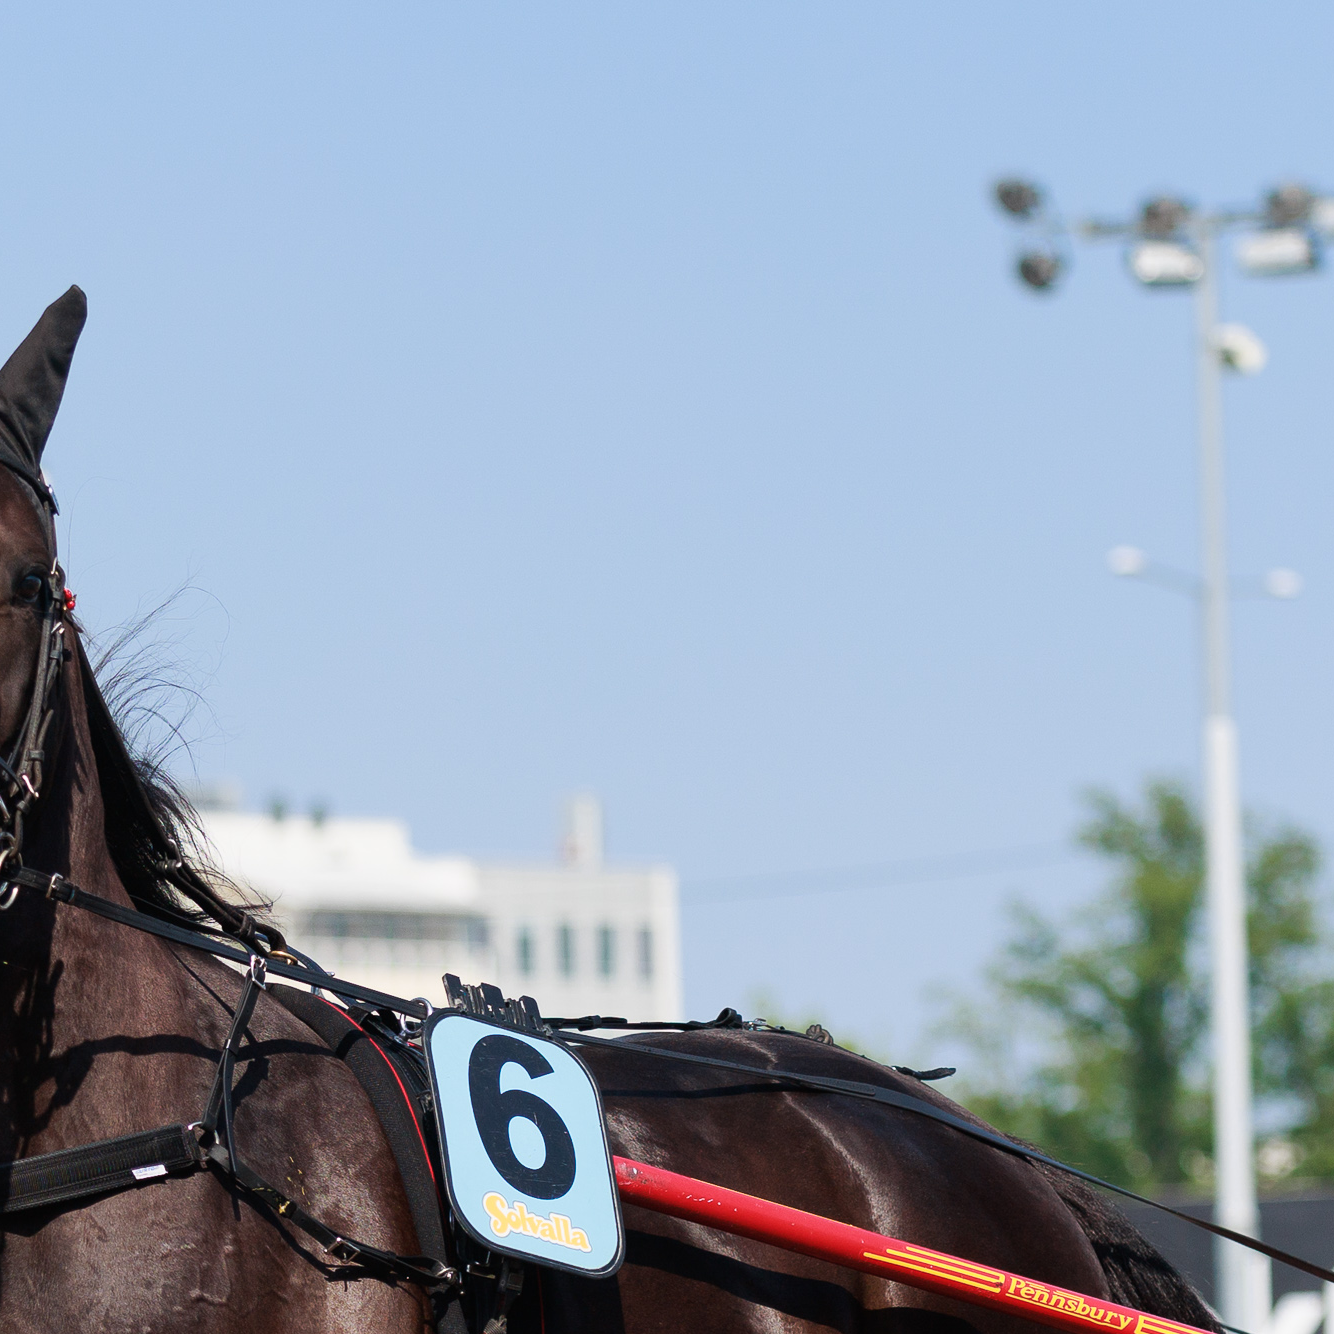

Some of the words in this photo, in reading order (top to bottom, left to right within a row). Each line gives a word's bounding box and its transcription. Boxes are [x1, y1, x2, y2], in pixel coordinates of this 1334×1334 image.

[468, 1034, 577, 1201] 6
[483, 1192, 591, 1252] Solvalla
[1008, 1276, 1134, 1330] Pennsbury
